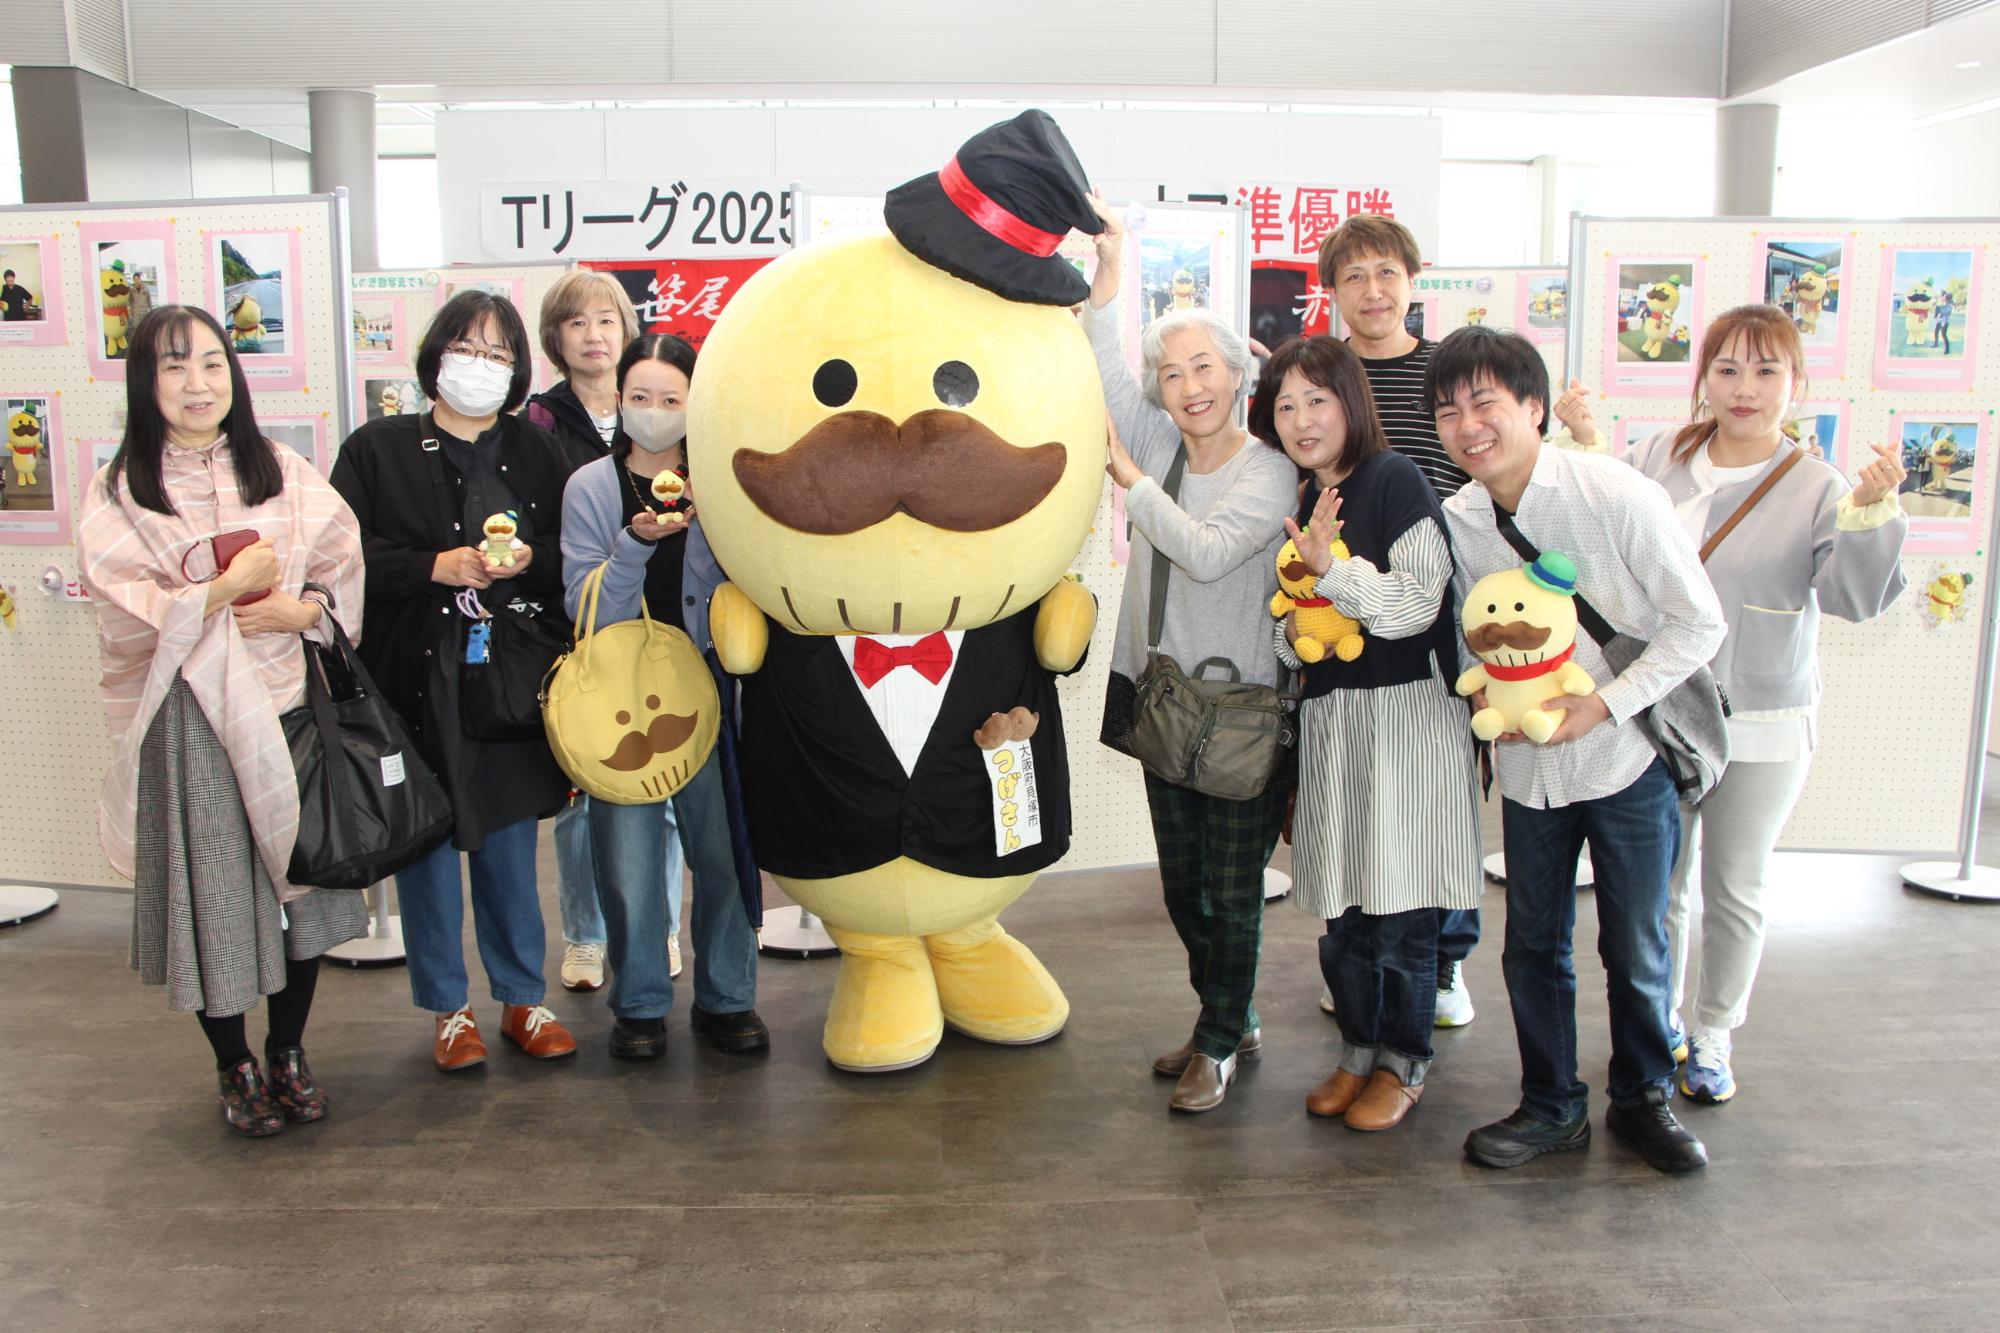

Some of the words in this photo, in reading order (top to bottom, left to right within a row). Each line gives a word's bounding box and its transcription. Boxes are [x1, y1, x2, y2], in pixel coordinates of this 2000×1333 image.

[992, 749, 1021, 853] つげさん
[1019, 744, 1038, 827] 大阪府貝塚市
